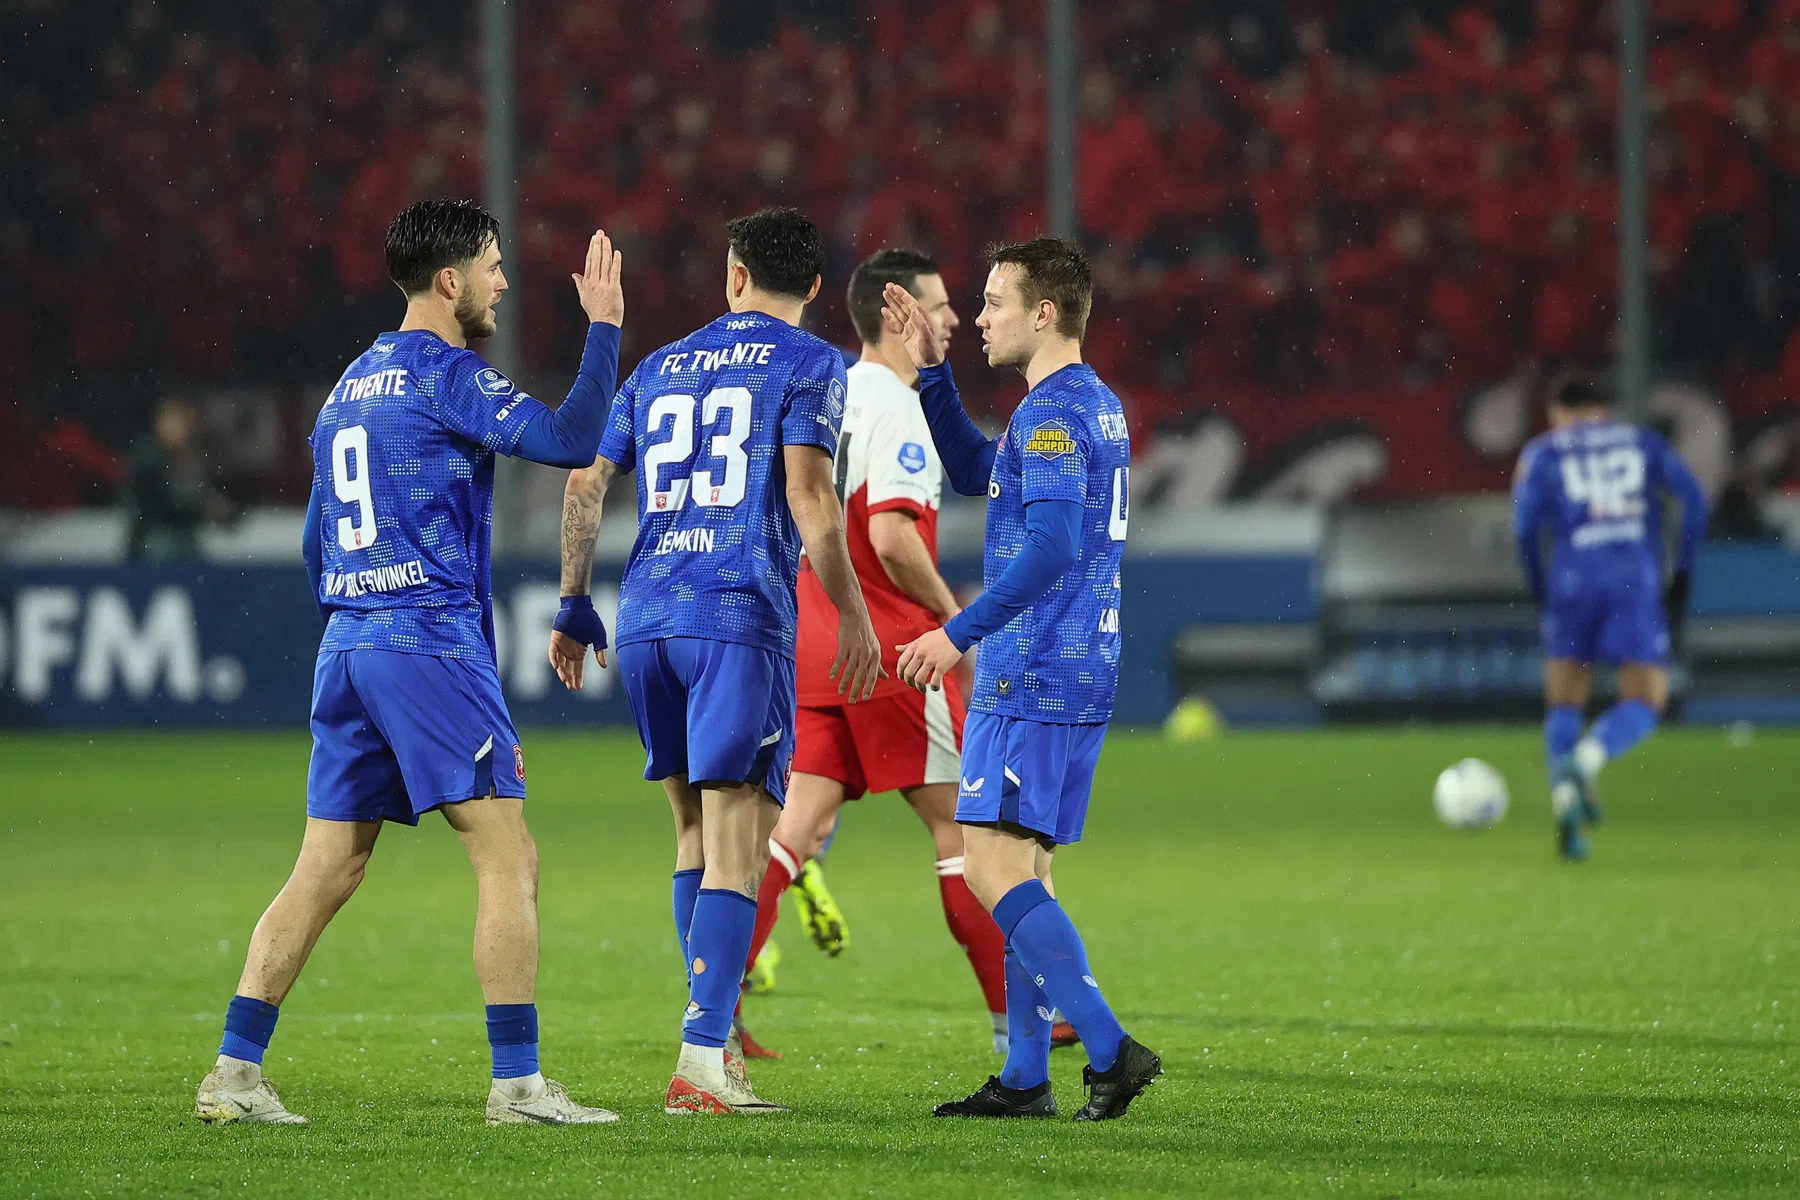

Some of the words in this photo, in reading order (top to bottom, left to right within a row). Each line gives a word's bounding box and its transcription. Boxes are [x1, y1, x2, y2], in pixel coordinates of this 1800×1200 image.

[659, 353, 689, 376] FC
[690, 342, 777, 372] TWENTE
[341, 368, 408, 403] TWENTE
[643, 386, 753, 514] 23
[1025, 440, 1072, 452] JACKPOT
[1035, 430, 1062, 441] EURO
[331, 424, 378, 552] 9
[1560, 449, 1647, 518] 42
[0, 584, 247, 703] FM.
